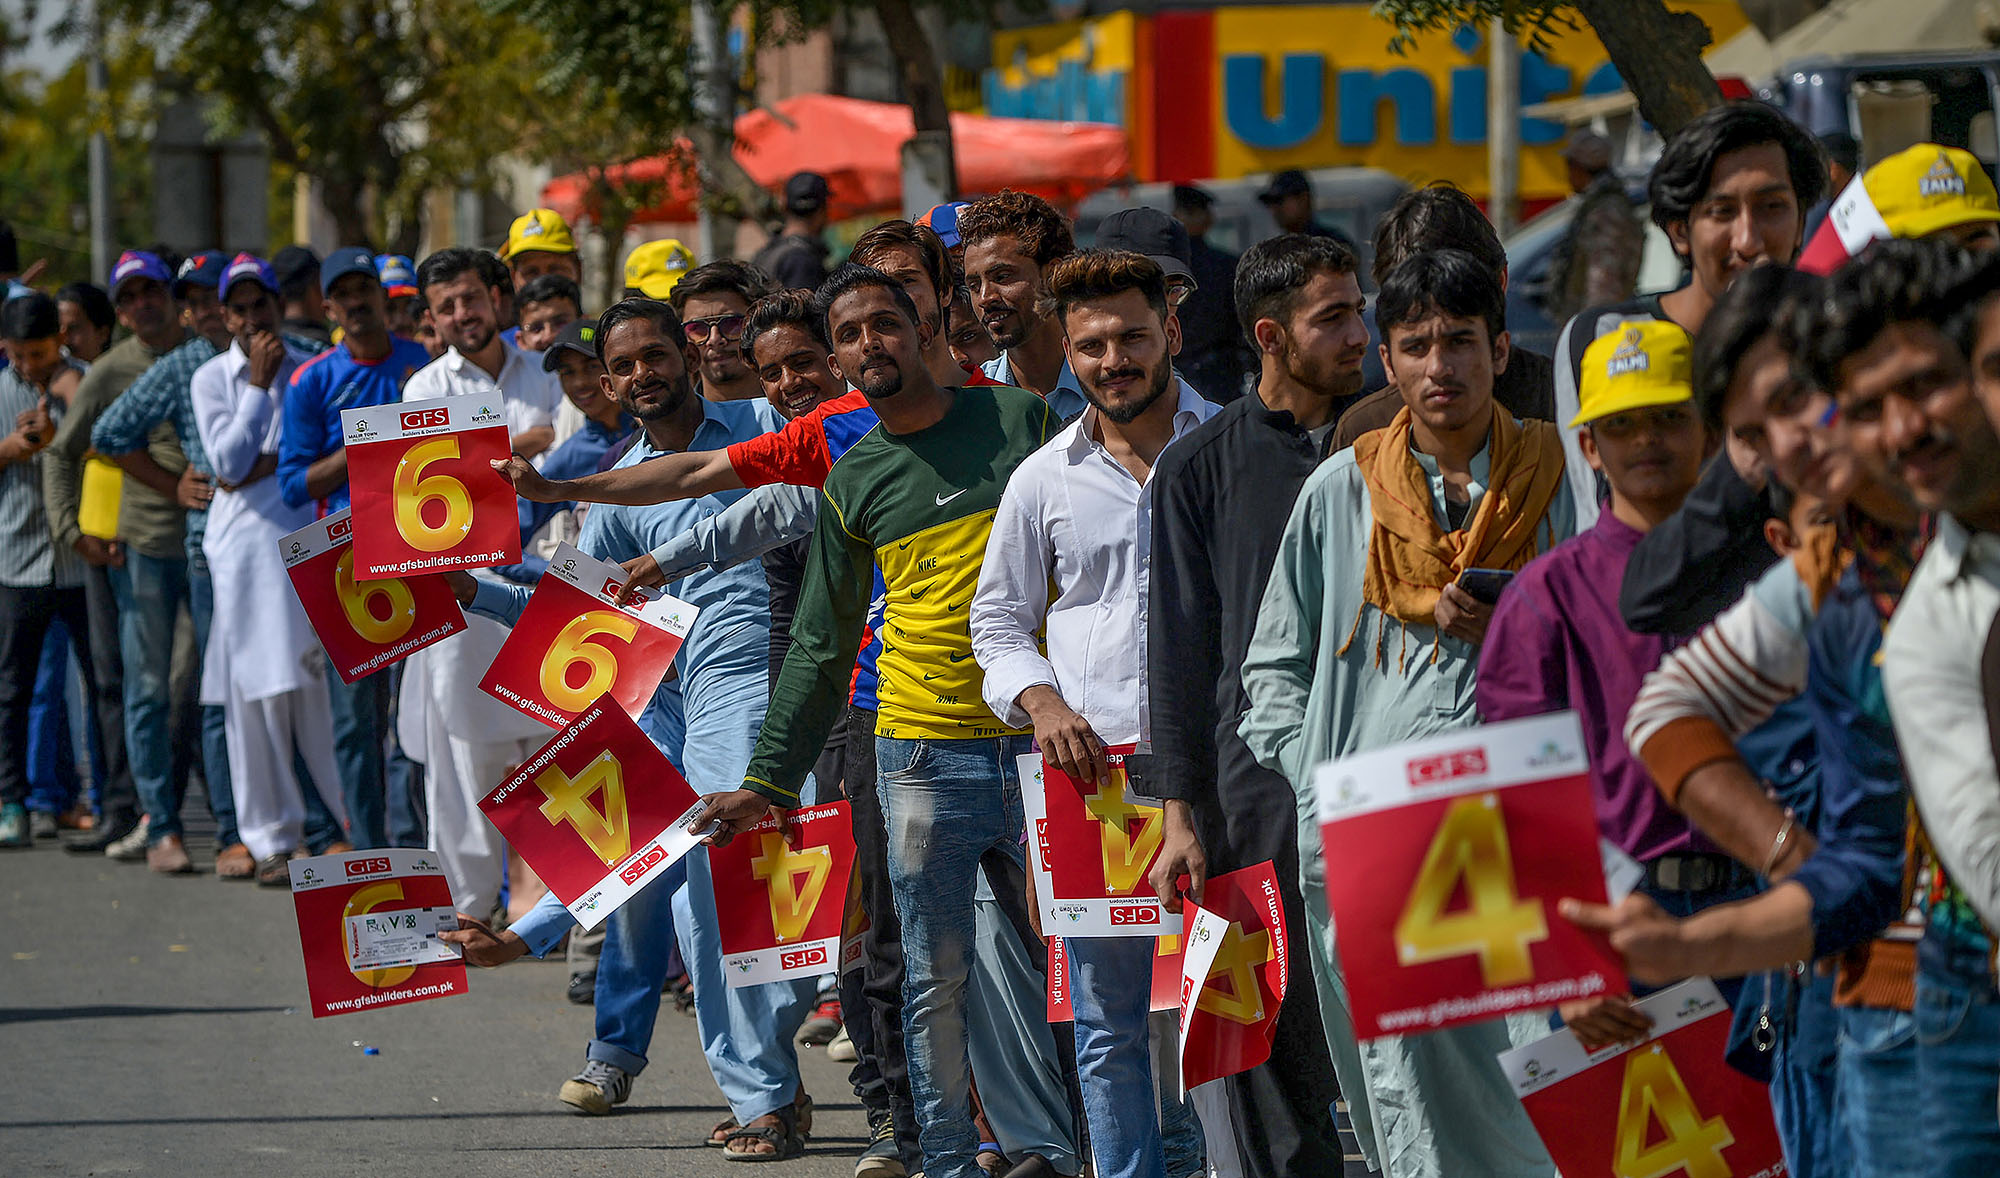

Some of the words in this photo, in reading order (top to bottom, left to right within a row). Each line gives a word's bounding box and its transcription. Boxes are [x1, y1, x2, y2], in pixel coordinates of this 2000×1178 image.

[1225, 23, 1624, 149] Unit
[403, 409, 447, 428] GFS
[425, 427, 451, 435] Developers
[471, 414, 487, 422] North
[393, 435, 474, 553] 6
[330, 518, 352, 537] GF
[370, 550, 505, 574] www.gfsbuilders.com.pk
[566, 571, 579, 582] TOWN
[917, 556, 937, 573] NIKE
[335, 542, 416, 644] 6
[606, 582, 645, 608] GS
[349, 621, 454, 677] www.gfsbuilders.com.pk
[539, 610, 641, 713] 6
[935, 694, 959, 705] NIKE
[880, 727, 896, 738] NIKE
[492, 708, 603, 804] www.gfsbuilders.com.pk
[533, 748, 632, 870] 4
[1084, 767, 1165, 896] 4
[348, 858, 389, 874] GFS
[624, 849, 664, 882] GFS
[751, 832, 833, 945] 4
[1394, 792, 1549, 988] 4
[1113, 907, 1157, 924] GFS
[783, 949, 825, 968] GFS
[1198, 921, 1275, 1025] 4
[326, 980, 454, 1012] www.gfsbuilders.com.pk
[1612, 1040, 1735, 1178] 4
